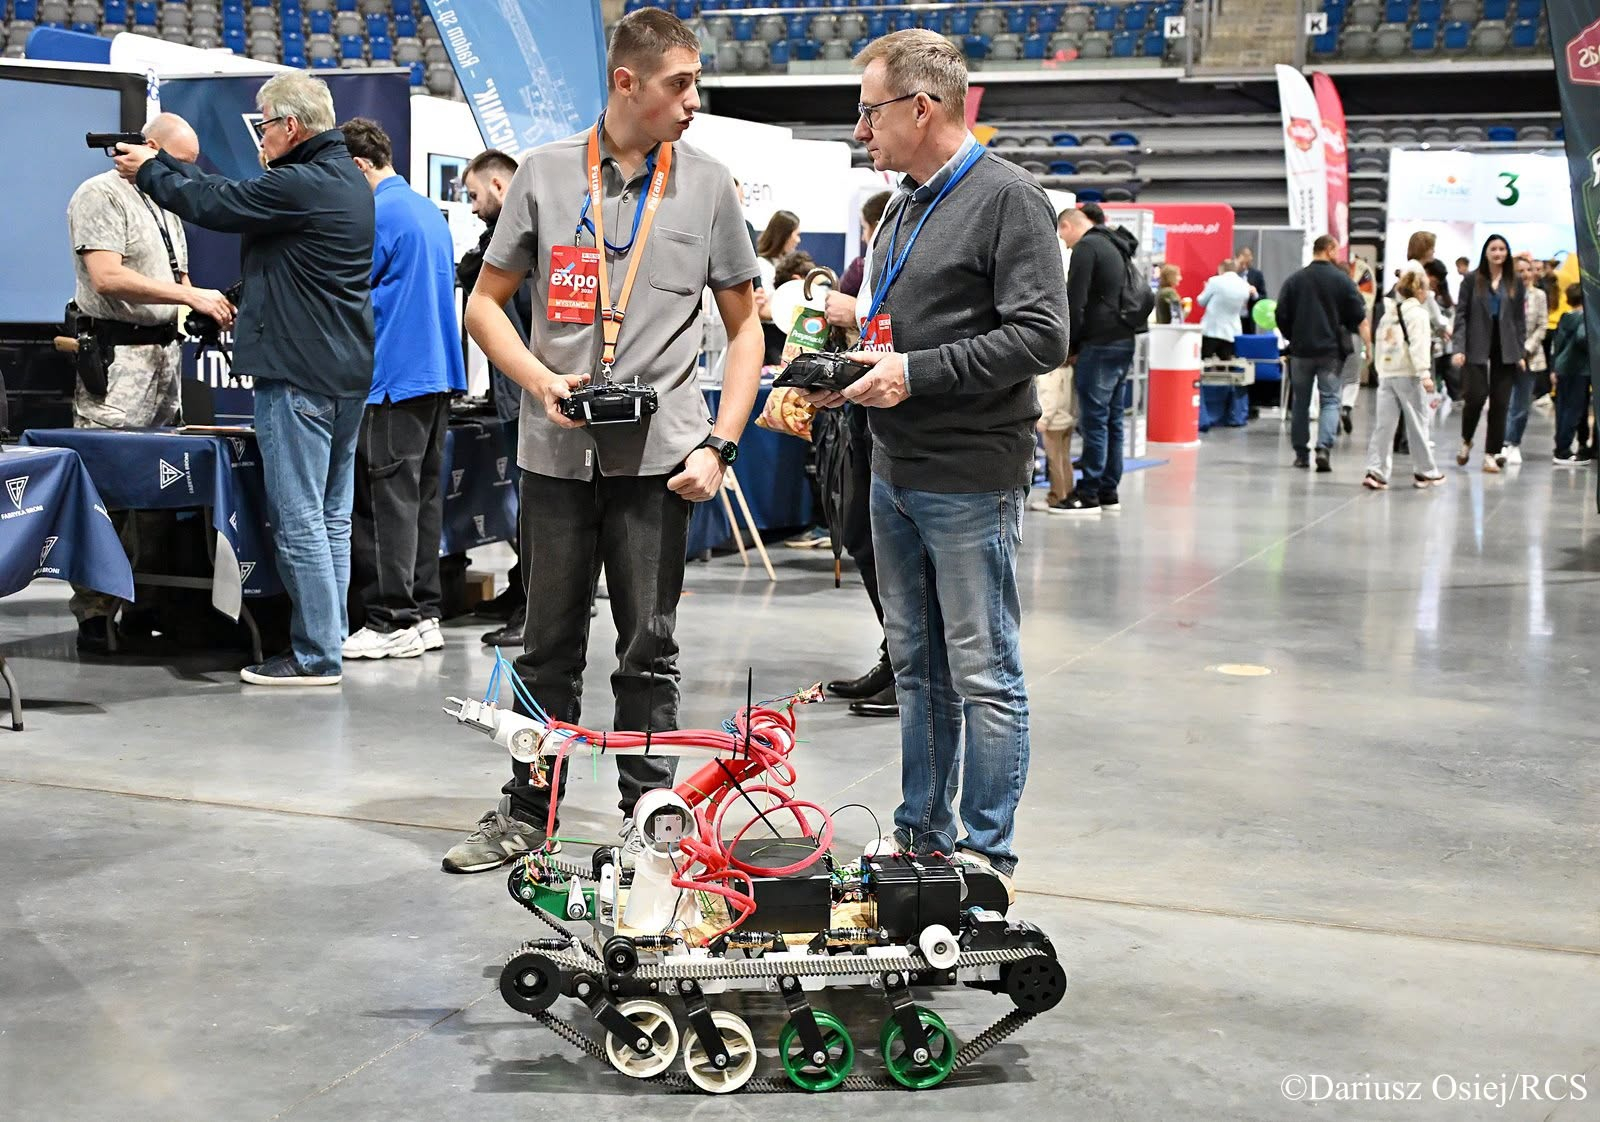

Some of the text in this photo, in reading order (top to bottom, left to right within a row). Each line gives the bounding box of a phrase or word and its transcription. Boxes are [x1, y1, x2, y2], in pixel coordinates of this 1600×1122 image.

[1169, 23, 1180, 34] K
[1311, 20, 1321, 31] K
[591, 164, 600, 206] Futaba
[647, 170, 665, 211] Futaba
[741, 182, 773, 207] gen
[1496, 172, 1520, 206] 3
[551, 272, 597, 291] expo
[1, 504, 44, 520] FABRYKA BRONI
